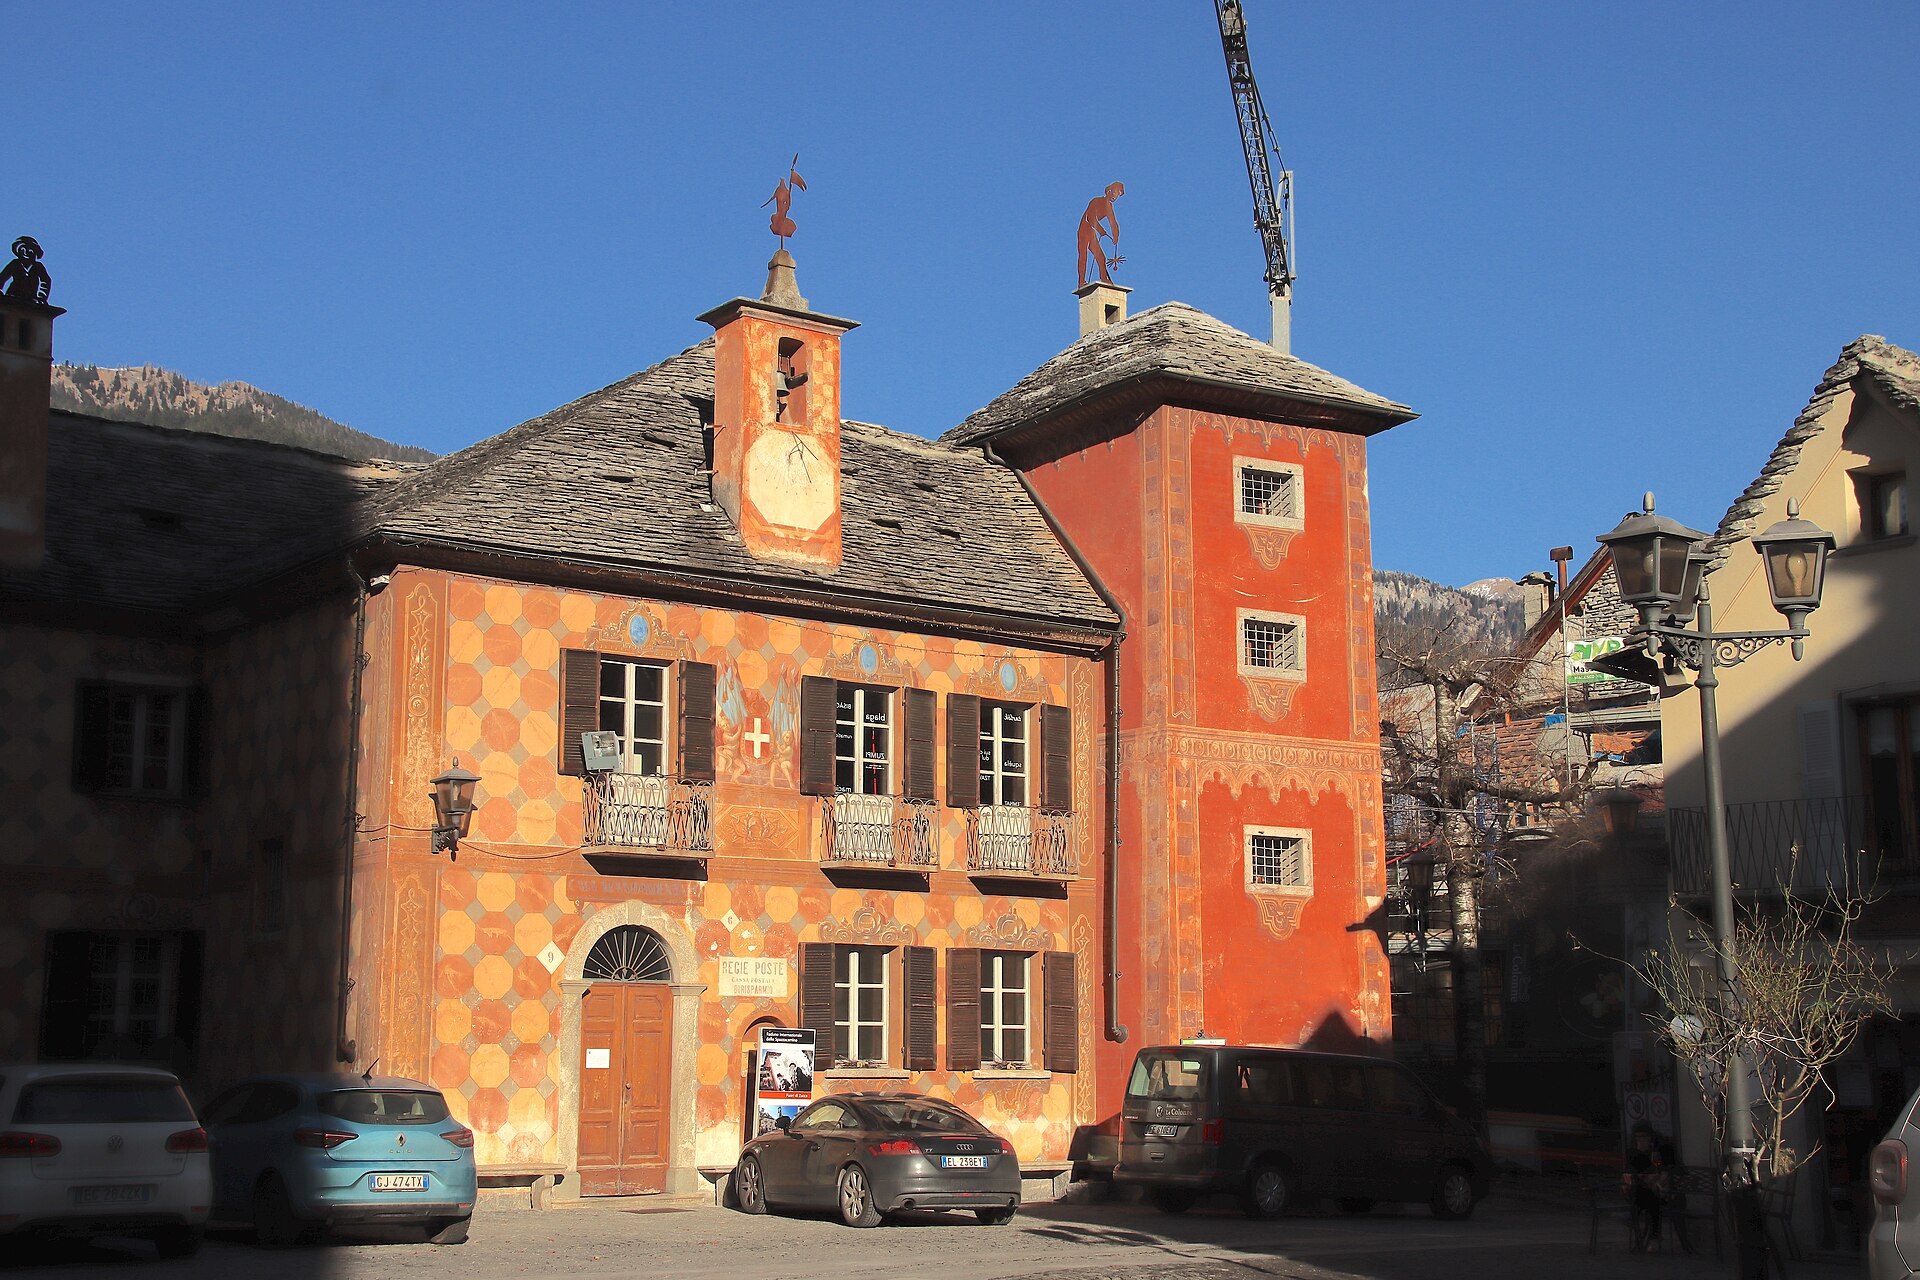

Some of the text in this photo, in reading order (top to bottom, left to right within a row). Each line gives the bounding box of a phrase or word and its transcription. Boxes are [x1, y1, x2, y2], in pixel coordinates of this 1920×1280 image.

[727, 915, 733, 925] 6
[547, 951, 554, 964] 9
[722, 960, 784, 976] REGIE POSTE
[376, 1176, 423, 1188] GJ 474TX
